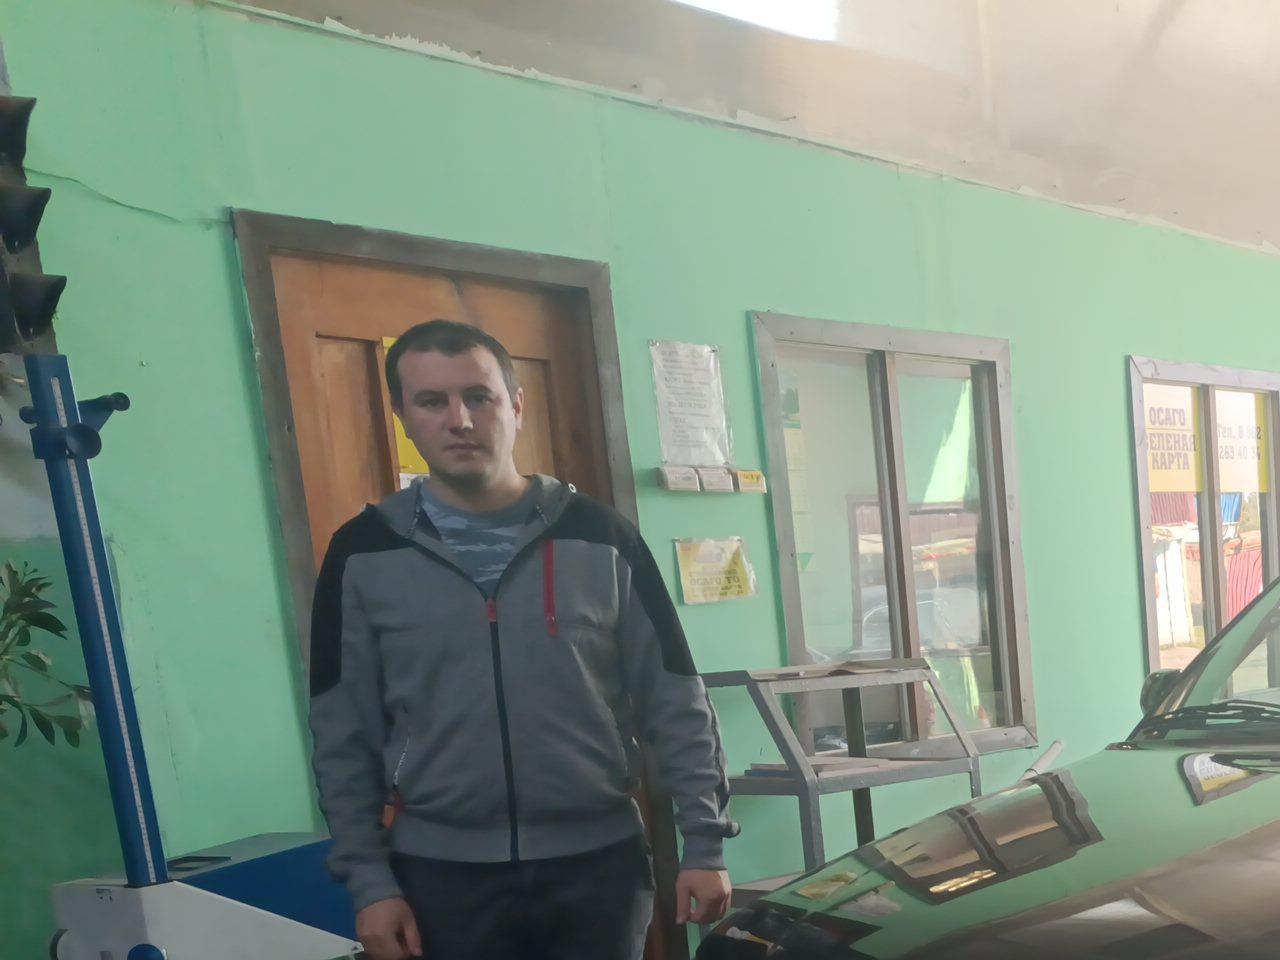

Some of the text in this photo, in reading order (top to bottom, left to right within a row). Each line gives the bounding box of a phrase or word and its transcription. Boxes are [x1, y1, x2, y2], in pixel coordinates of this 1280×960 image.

[1148, 406, 1187, 426] ОСАГО
[1147, 432, 1197, 452] ЕЛЕНАЯ
[1151, 452, 1191, 471] КАРТА
